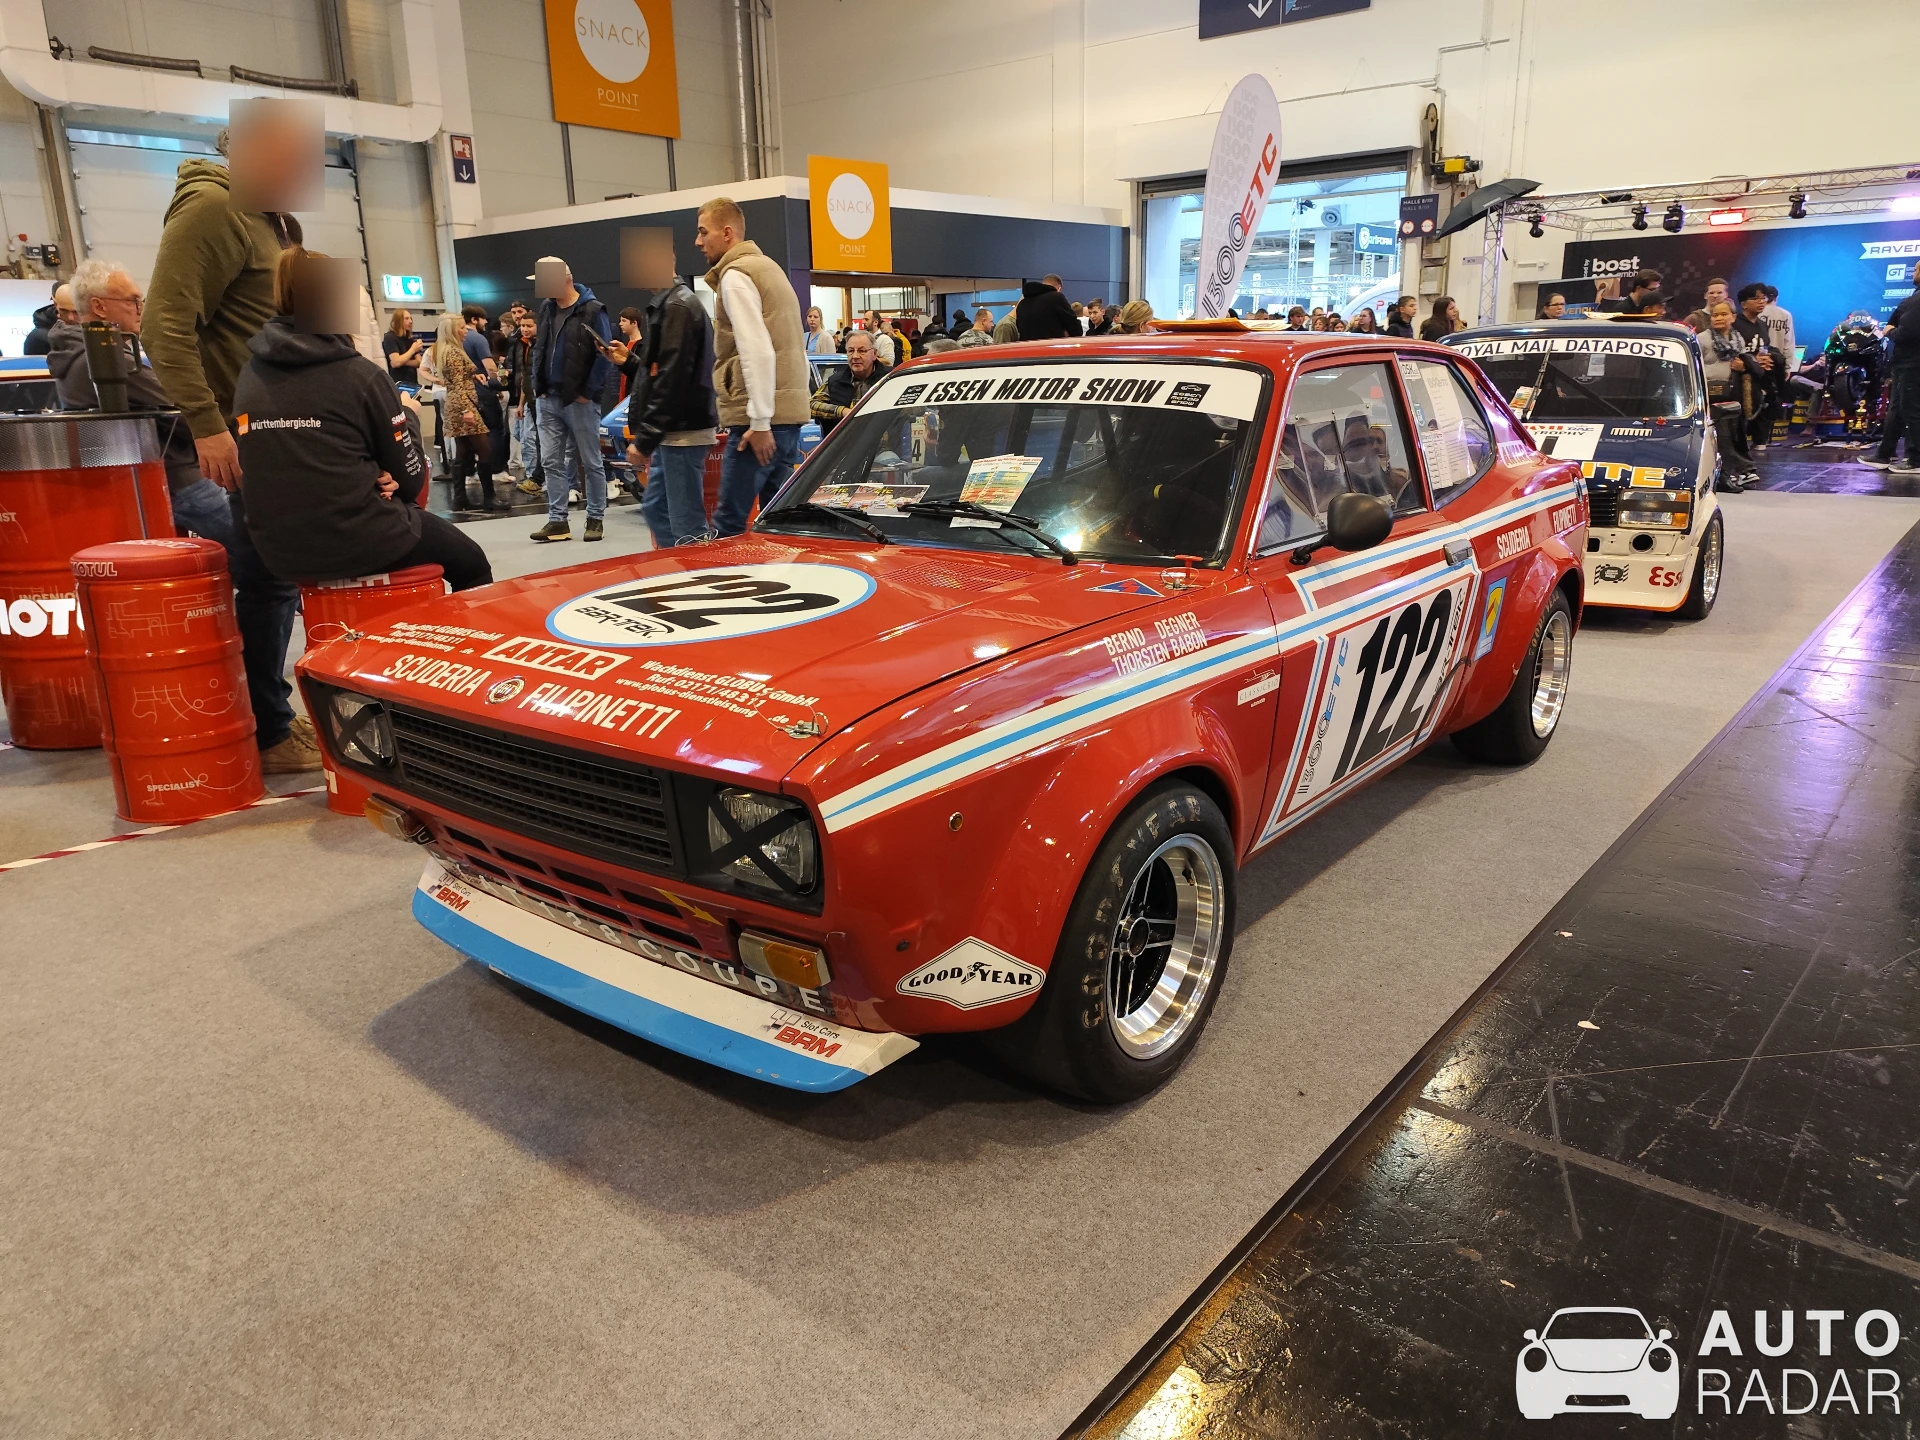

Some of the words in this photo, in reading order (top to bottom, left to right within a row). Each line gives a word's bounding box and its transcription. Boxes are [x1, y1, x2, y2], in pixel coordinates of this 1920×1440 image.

[577, 16, 648, 48] SNACK
[597, 87, 639, 106] POINT
[828, 198, 872, 214] SNACK
[839, 243, 867, 254] POINT
[1591, 255, 1641, 273] bost
[1456, 342, 1504, 358] OYAL
[1511, 339, 1560, 355] MAIL
[1565, 339, 1670, 359] DATAPOST
[923, 379, 996, 403] ESSEN
[991, 377, 1082, 403] MOTOR
[1079, 378, 1166, 404] SHOW
[251, 417, 321, 431] württembergische
[1581, 460, 1666, 489] ITE
[1496, 525, 1532, 559] SCUDERIA
[186, 603, 227, 618] AUTHENTIC
[591, 574, 841, 630] 122
[1103, 627, 1146, 656] BERND
[1154, 611, 1201, 640] DEGNER
[490, 638, 615, 677] ANTAR
[1111, 642, 1171, 677] THORSTEN
[1169, 629, 1208, 657] BABON
[639, 660, 718, 683] Wachdienst
[713, 674, 774, 698] GLOBUS
[768, 689, 821, 708] GmbH
[646, 673, 676, 685] Ruf:
[1329, 588, 1453, 786] 122
[382, 653, 493, 697] SCUDERIA
[516, 682, 682, 740] FILIPINETTI
[615, 677, 759, 719] www.globus-dienstleistung
[767, 713, 790, 725] .de
[147, 779, 201, 792] SPECIALIST
[435, 886, 471, 912] BRM
[637, 938, 826, 1013] COUPE
[908, 967, 963, 988] GOOD
[978, 968, 1033, 986] YEAR
[773, 1025, 843, 1059] BRM
[800, 1020, 818, 1032] Slot
[817, 1026, 841, 1040] Cars
